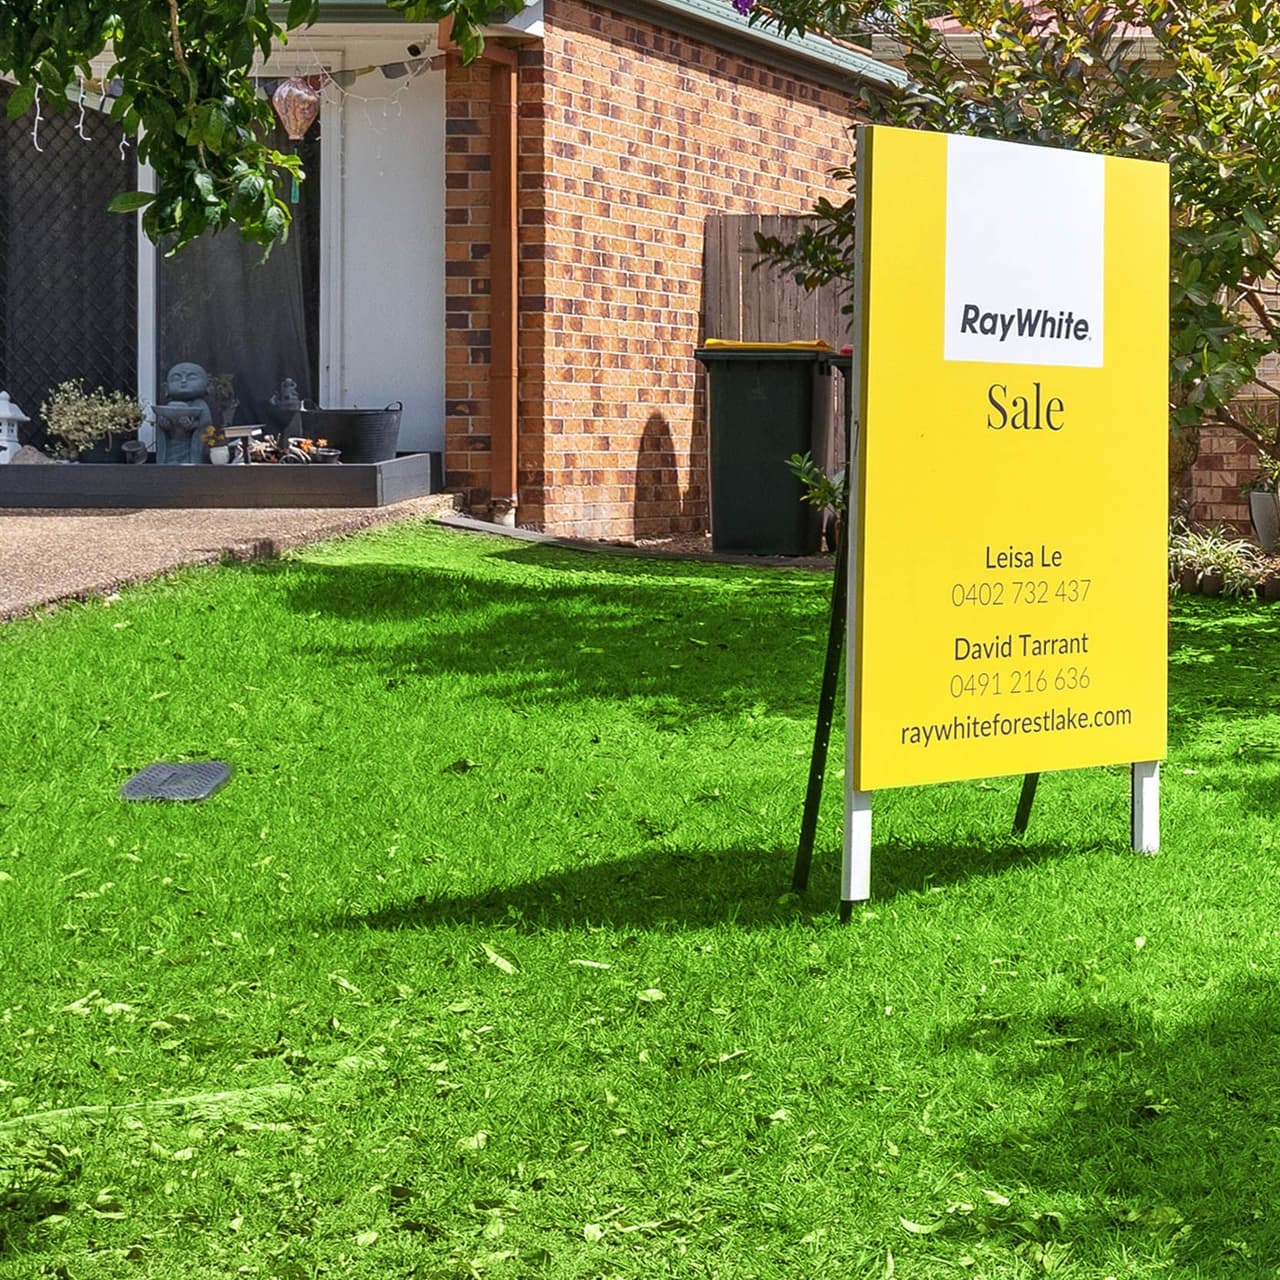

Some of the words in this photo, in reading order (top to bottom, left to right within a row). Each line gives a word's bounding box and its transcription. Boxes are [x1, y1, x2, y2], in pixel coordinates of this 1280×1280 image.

[986, 381, 1065, 431] Sale
[985, 545, 1034, 570] Leisa
[1040, 544, 1063, 568] Le
[951, 582, 1004, 608] 0402
[1011, 580, 1049, 605] 732
[1054, 578, 1092, 603] 437
[954, 634, 1013, 662] David
[1017, 632, 1089, 657] Tarrant
[950, 673, 1002, 699] 0491
[1010, 669, 1048, 694] 216
[1054, 666, 1090, 691] 636
[901, 706, 1132, 748] raywhiteforestlake.com
